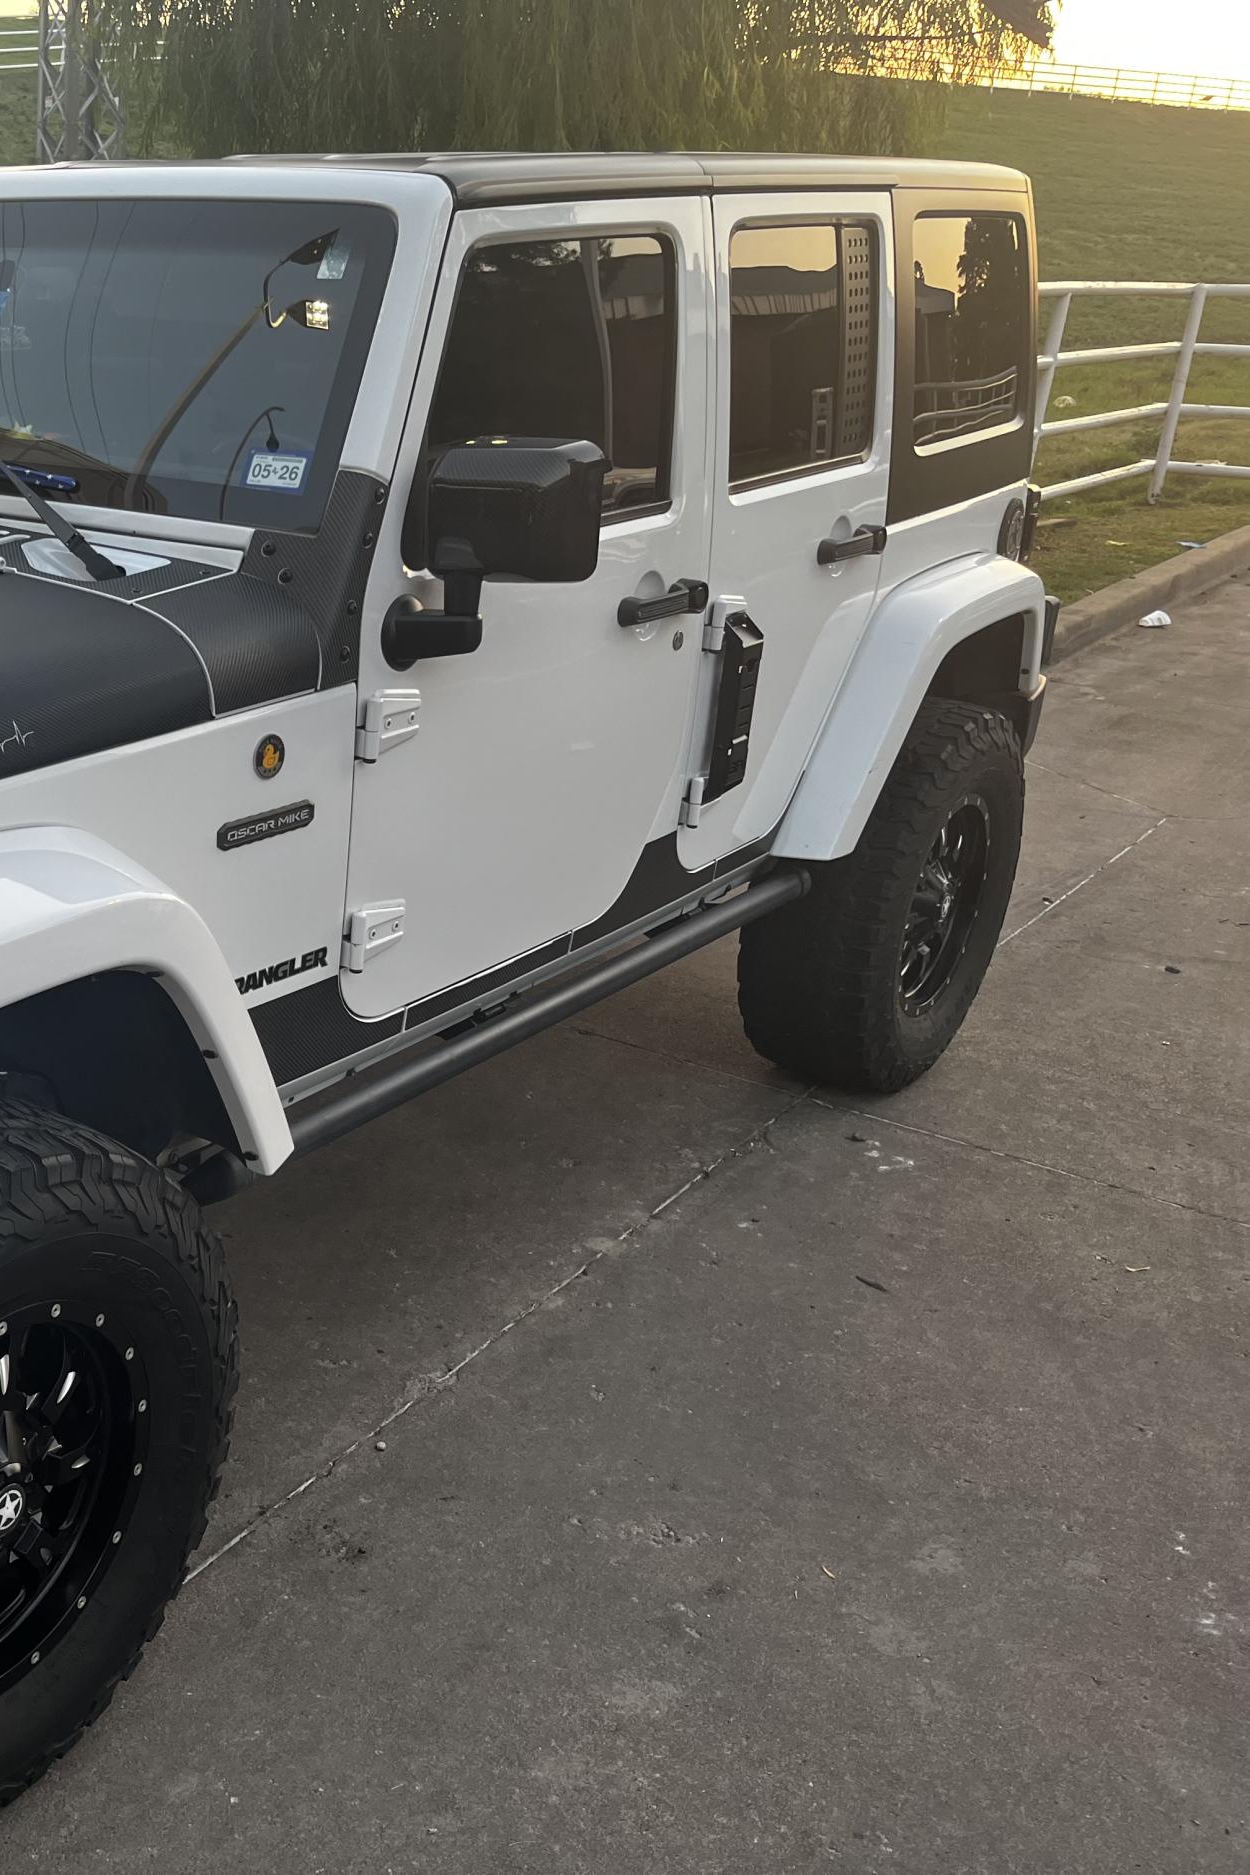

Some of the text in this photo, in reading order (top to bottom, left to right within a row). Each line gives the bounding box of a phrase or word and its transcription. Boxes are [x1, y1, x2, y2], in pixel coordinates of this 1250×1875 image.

[227, 808, 311, 841] OSCAR MIKE
[234, 946, 328, 995] RANGLER
